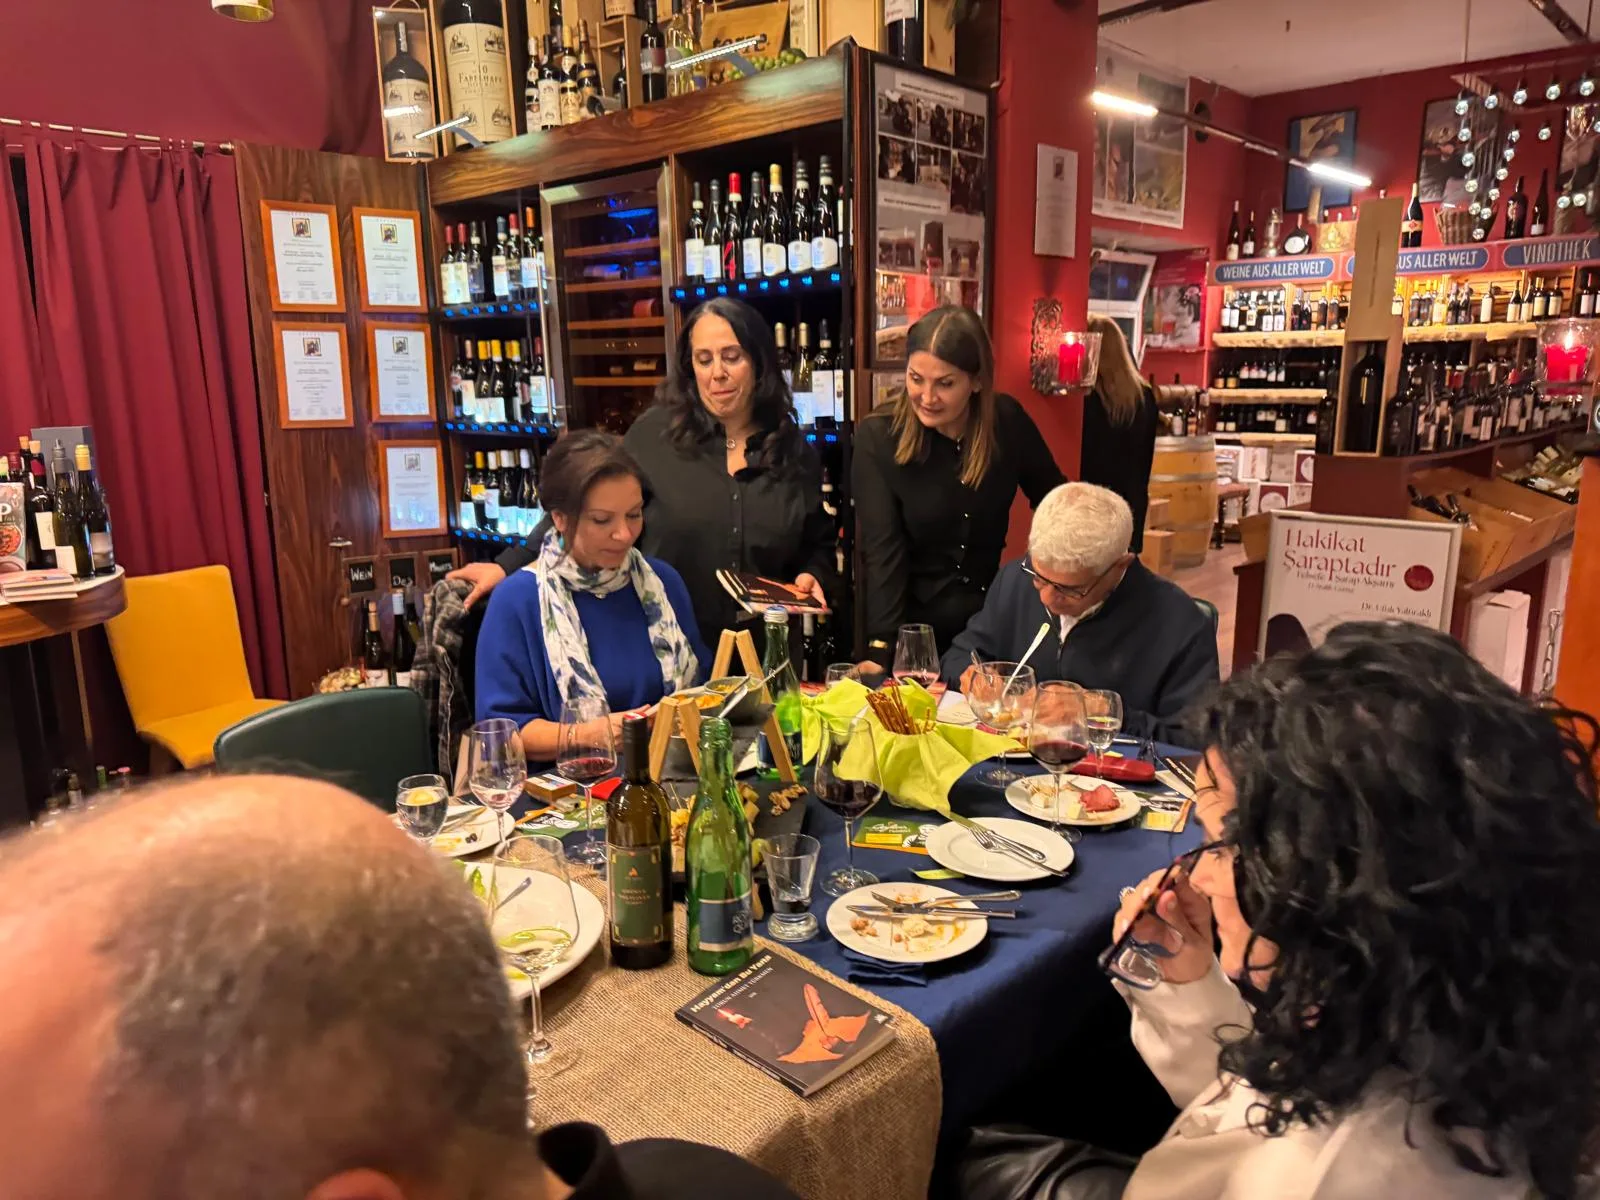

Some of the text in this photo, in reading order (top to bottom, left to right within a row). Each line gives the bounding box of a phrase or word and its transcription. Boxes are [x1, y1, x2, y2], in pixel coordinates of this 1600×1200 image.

[1396, 250, 1478, 269] US ALLER WELT
[1523, 239, 1591, 265] VINOTHEK
[1223, 261, 1325, 279] WEINE AUS ALLER WELT
[1285, 528, 1366, 553] Hakikat
